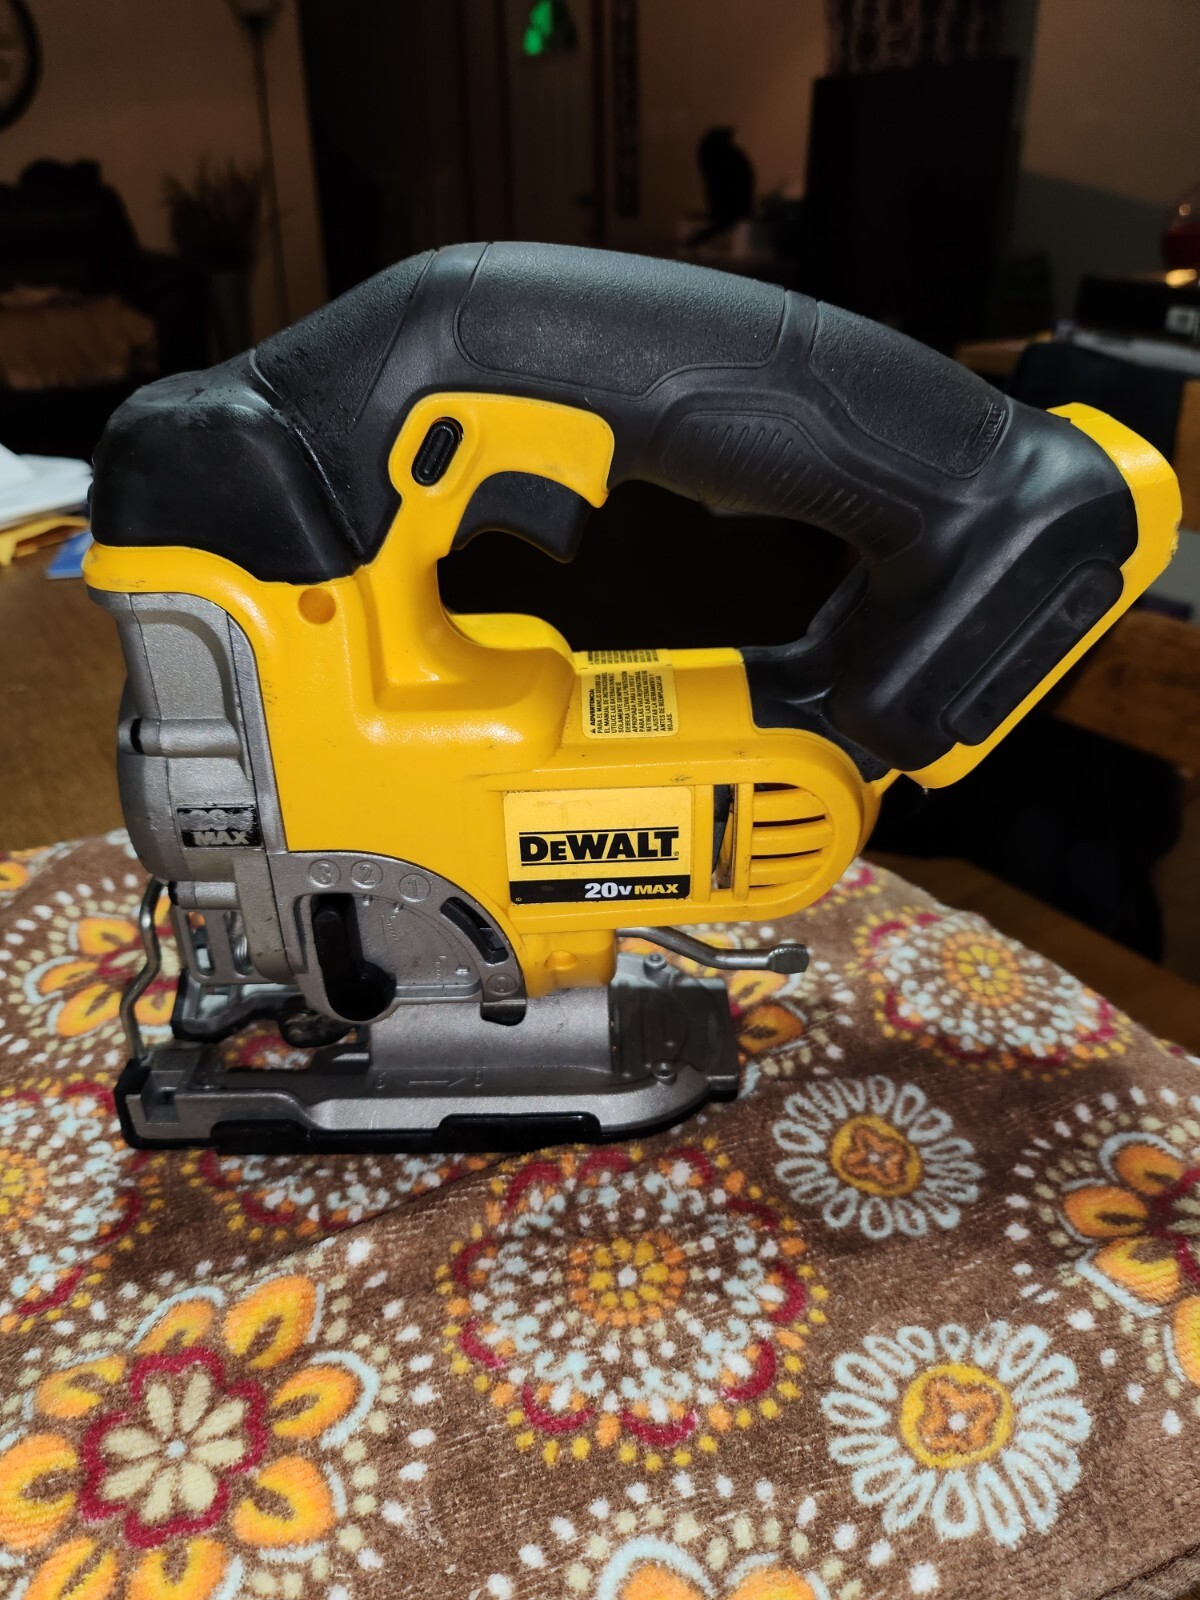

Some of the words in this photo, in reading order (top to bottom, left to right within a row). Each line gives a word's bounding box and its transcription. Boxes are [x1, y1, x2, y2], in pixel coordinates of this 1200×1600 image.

[193, 830, 251, 846] MAX
[519, 830, 678, 863] DEWALT
[634, 883, 679, 895] MAX
